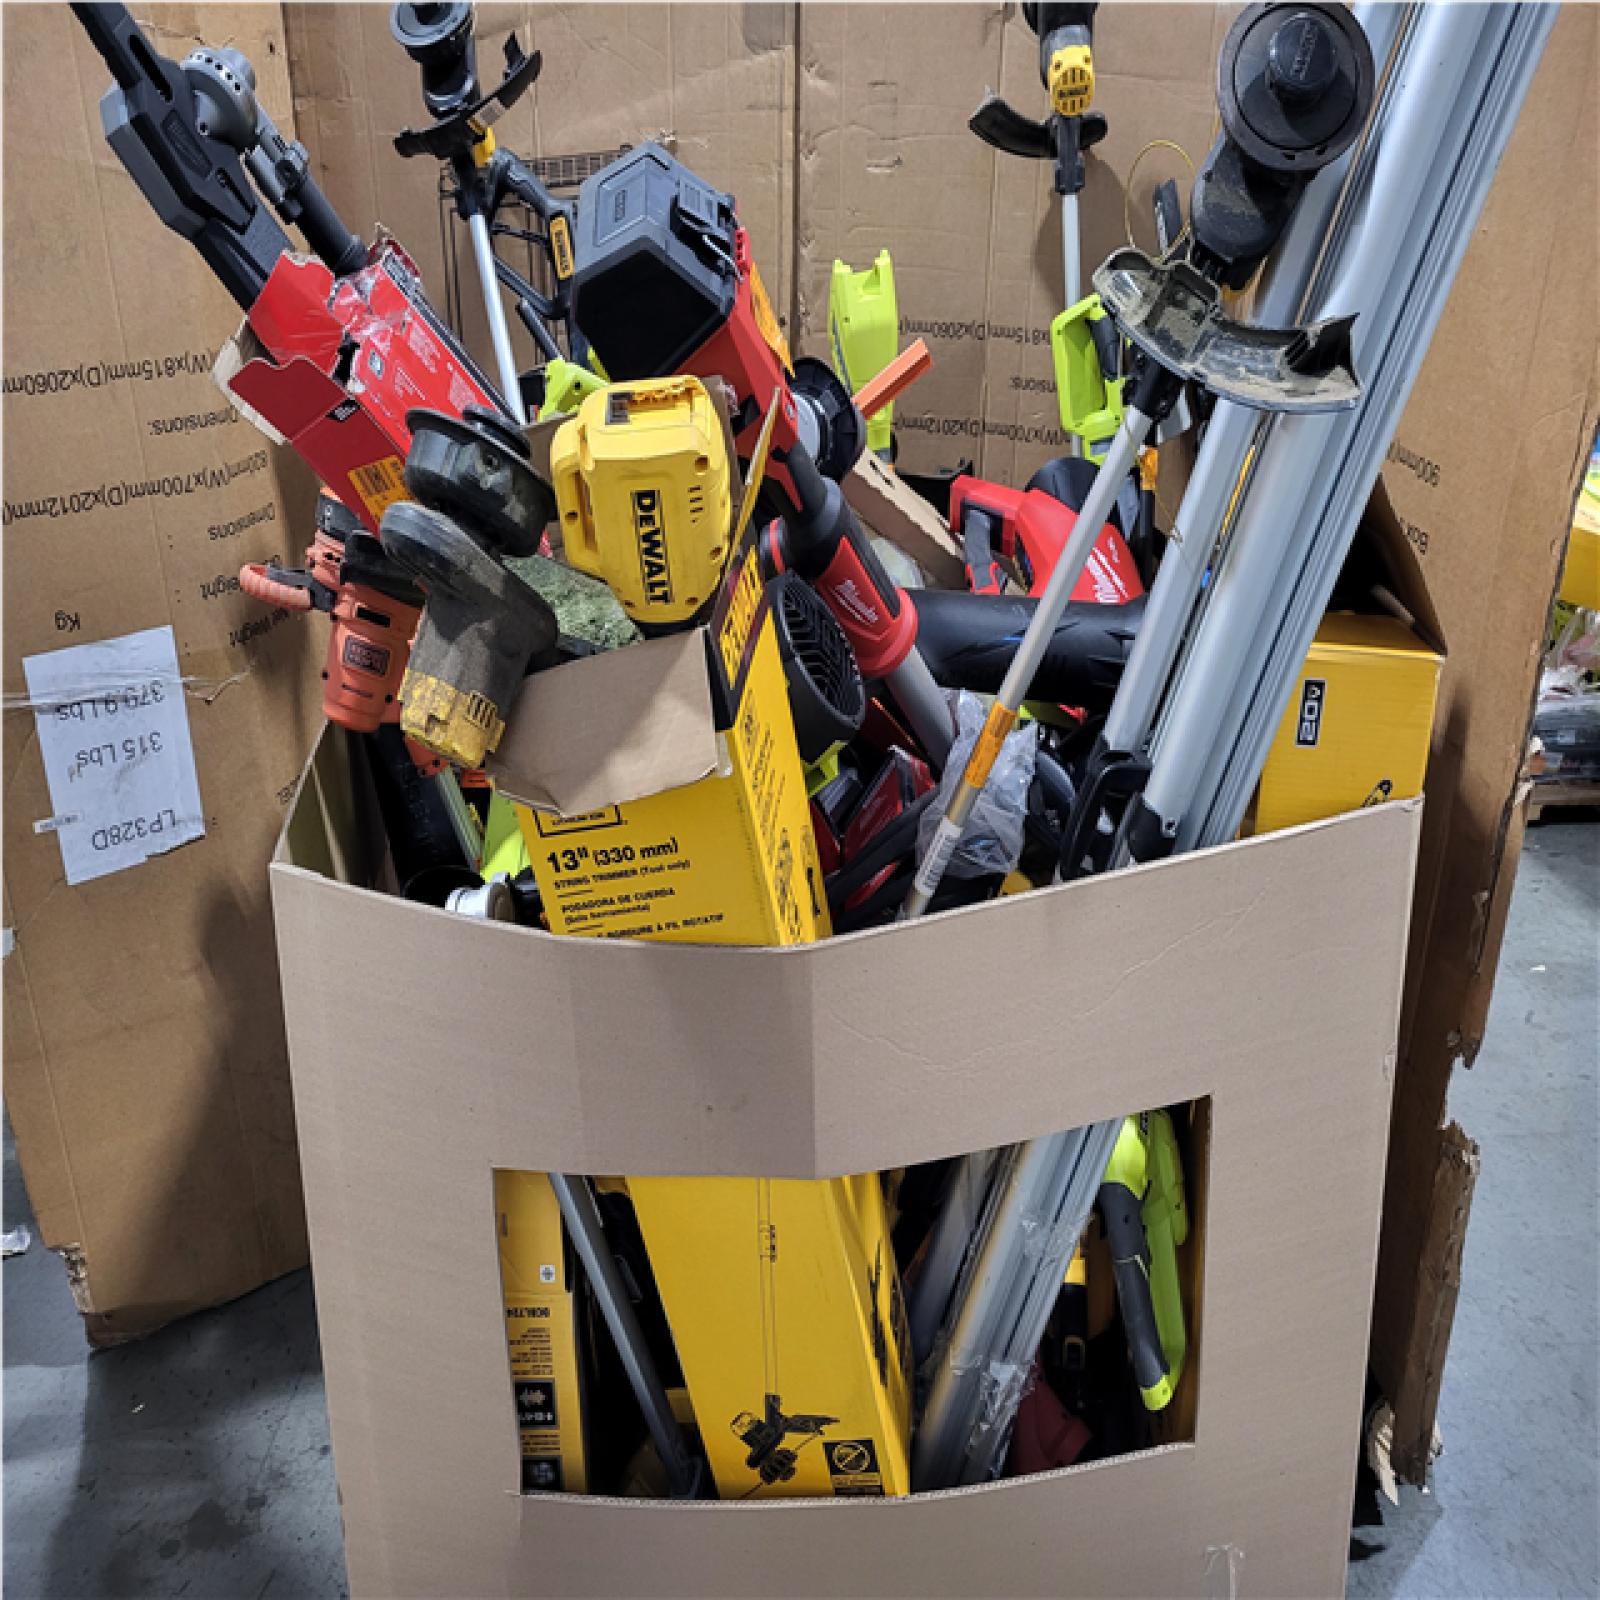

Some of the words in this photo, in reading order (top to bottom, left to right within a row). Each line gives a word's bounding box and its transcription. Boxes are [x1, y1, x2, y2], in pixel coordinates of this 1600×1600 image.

[637, 489, 670, 604] DEWALT
[200, 573, 242, 601] eight
[54, 609, 81, 632] Kg
[122, 731, 163, 761] 315
[91, 809, 177, 851] LP328D
[547, 846, 589, 874] 13"
[592, 845, 636, 867] (330
[639, 835, 679, 859] mm)
